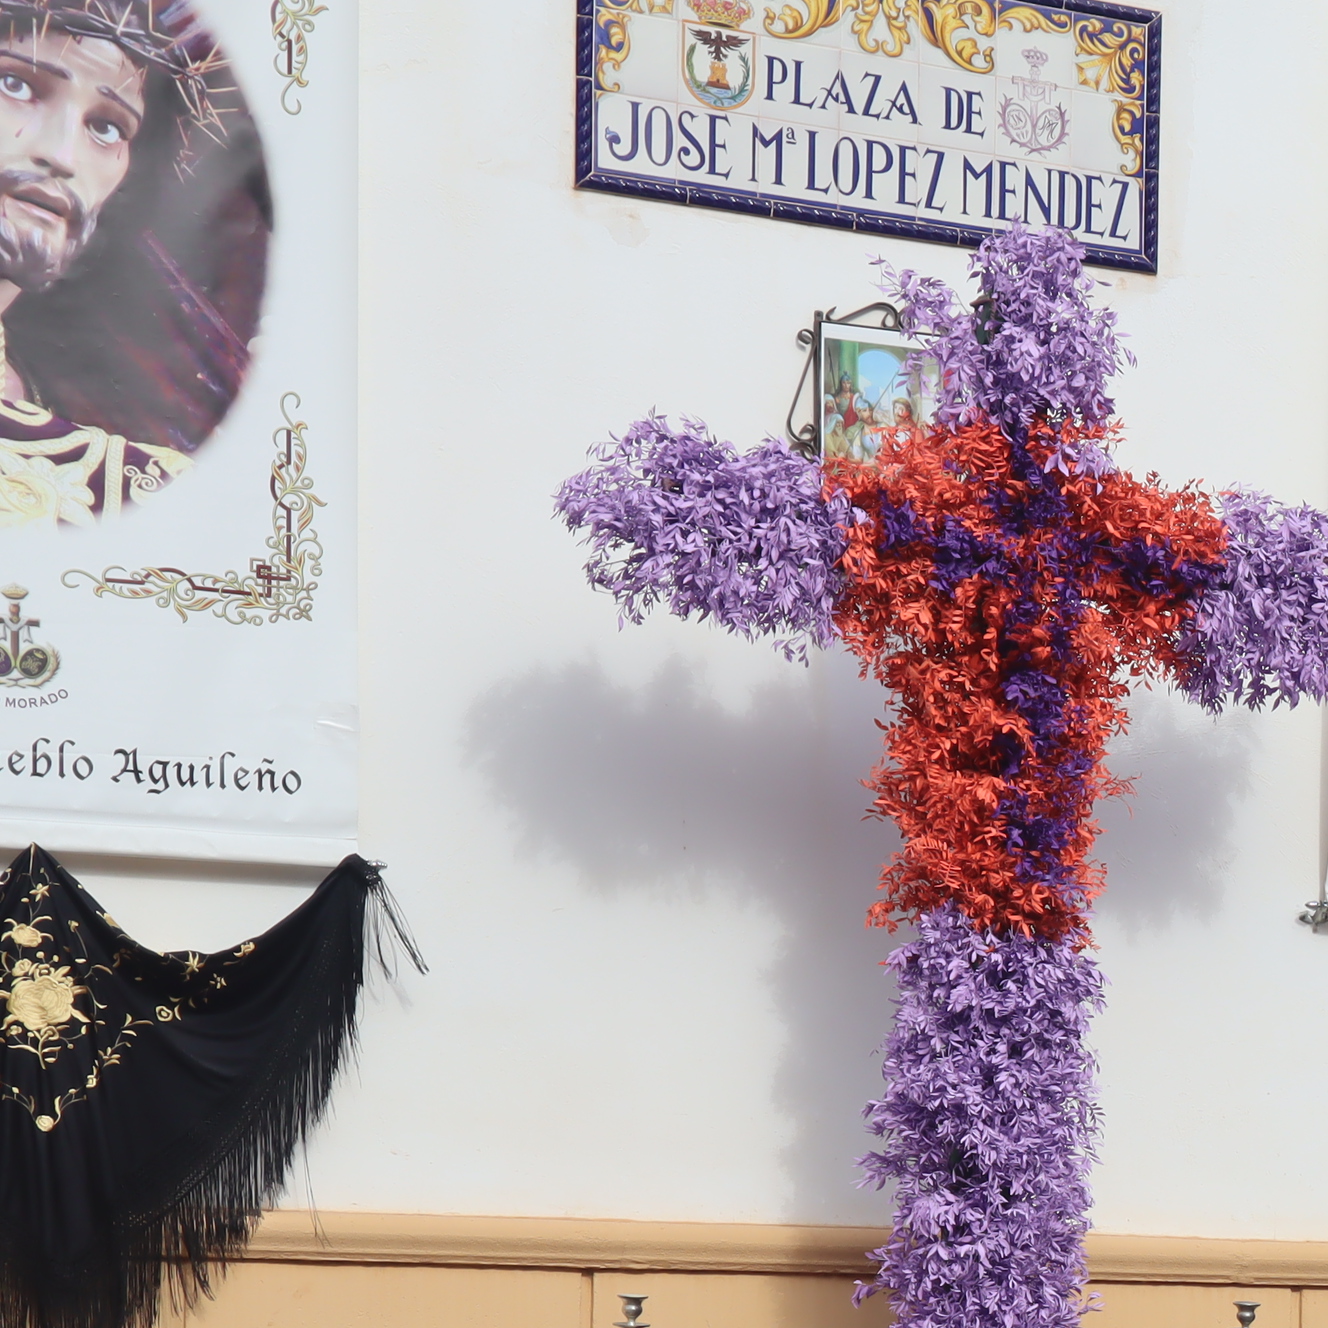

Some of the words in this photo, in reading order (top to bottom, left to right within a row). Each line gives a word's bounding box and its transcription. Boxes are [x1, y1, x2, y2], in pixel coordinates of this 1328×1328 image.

[764, 55, 923, 126] PLAZA
[941, 85, 987, 139] DE
[605, 101, 733, 181] JOSE
[749, 122, 796, 187] Mª
[805, 130, 948, 215] LOPEZ
[961, 154, 1131, 242] MENDEZ
[5, 688, 69, 709] MORADO
[0, 737, 94, 781] eblo
[110, 747, 303, 795] Aguileño
